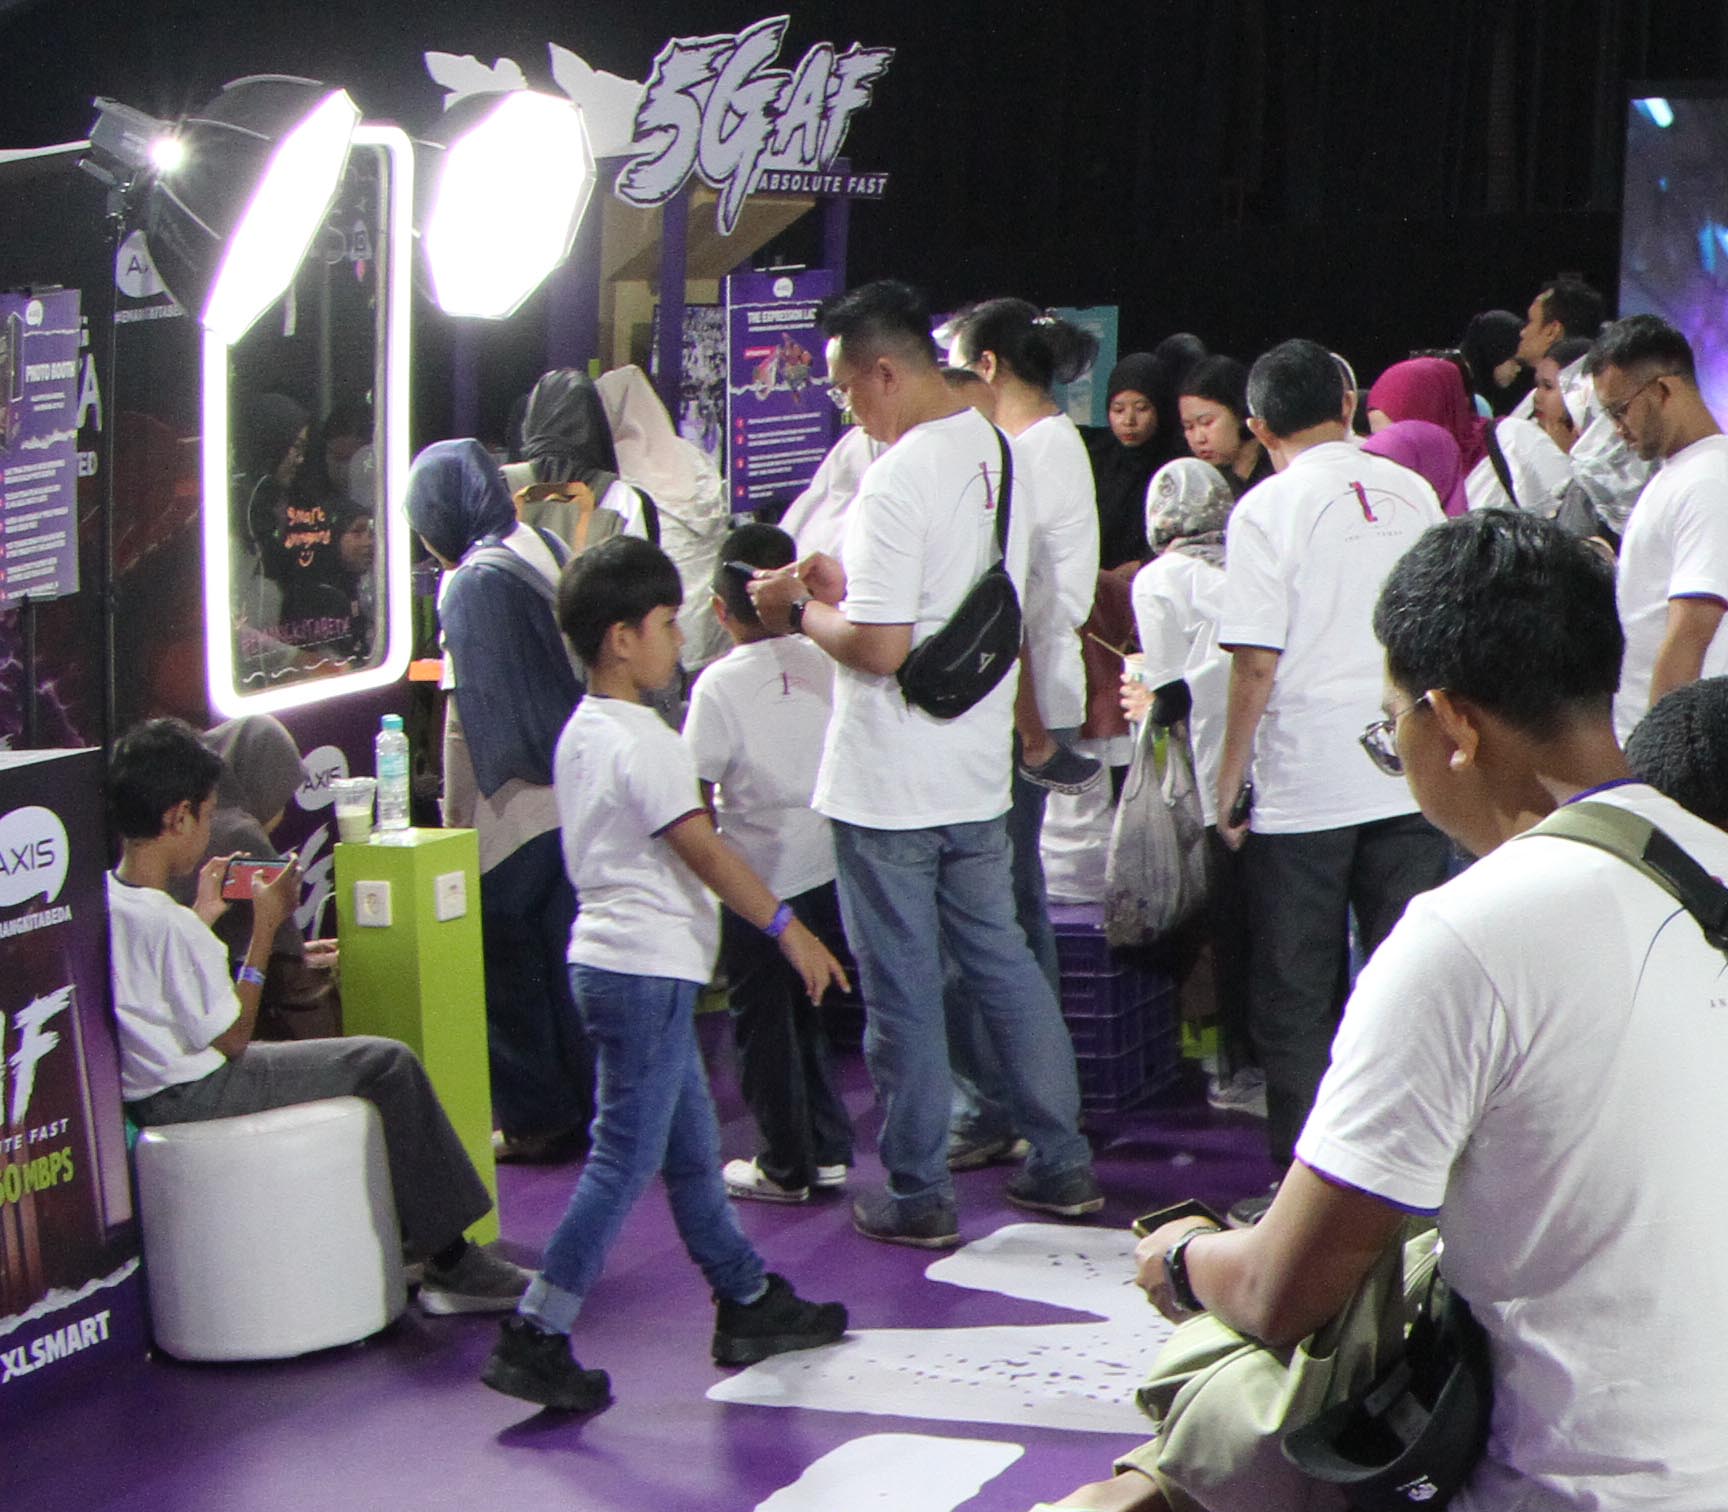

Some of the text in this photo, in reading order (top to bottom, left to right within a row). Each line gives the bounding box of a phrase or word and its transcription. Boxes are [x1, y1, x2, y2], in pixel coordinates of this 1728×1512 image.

[759, 173, 888, 194] ABSOLUTE FAST
[29, 1118, 70, 1145] FAST
[0, 1311, 111, 1384] XLSMART
